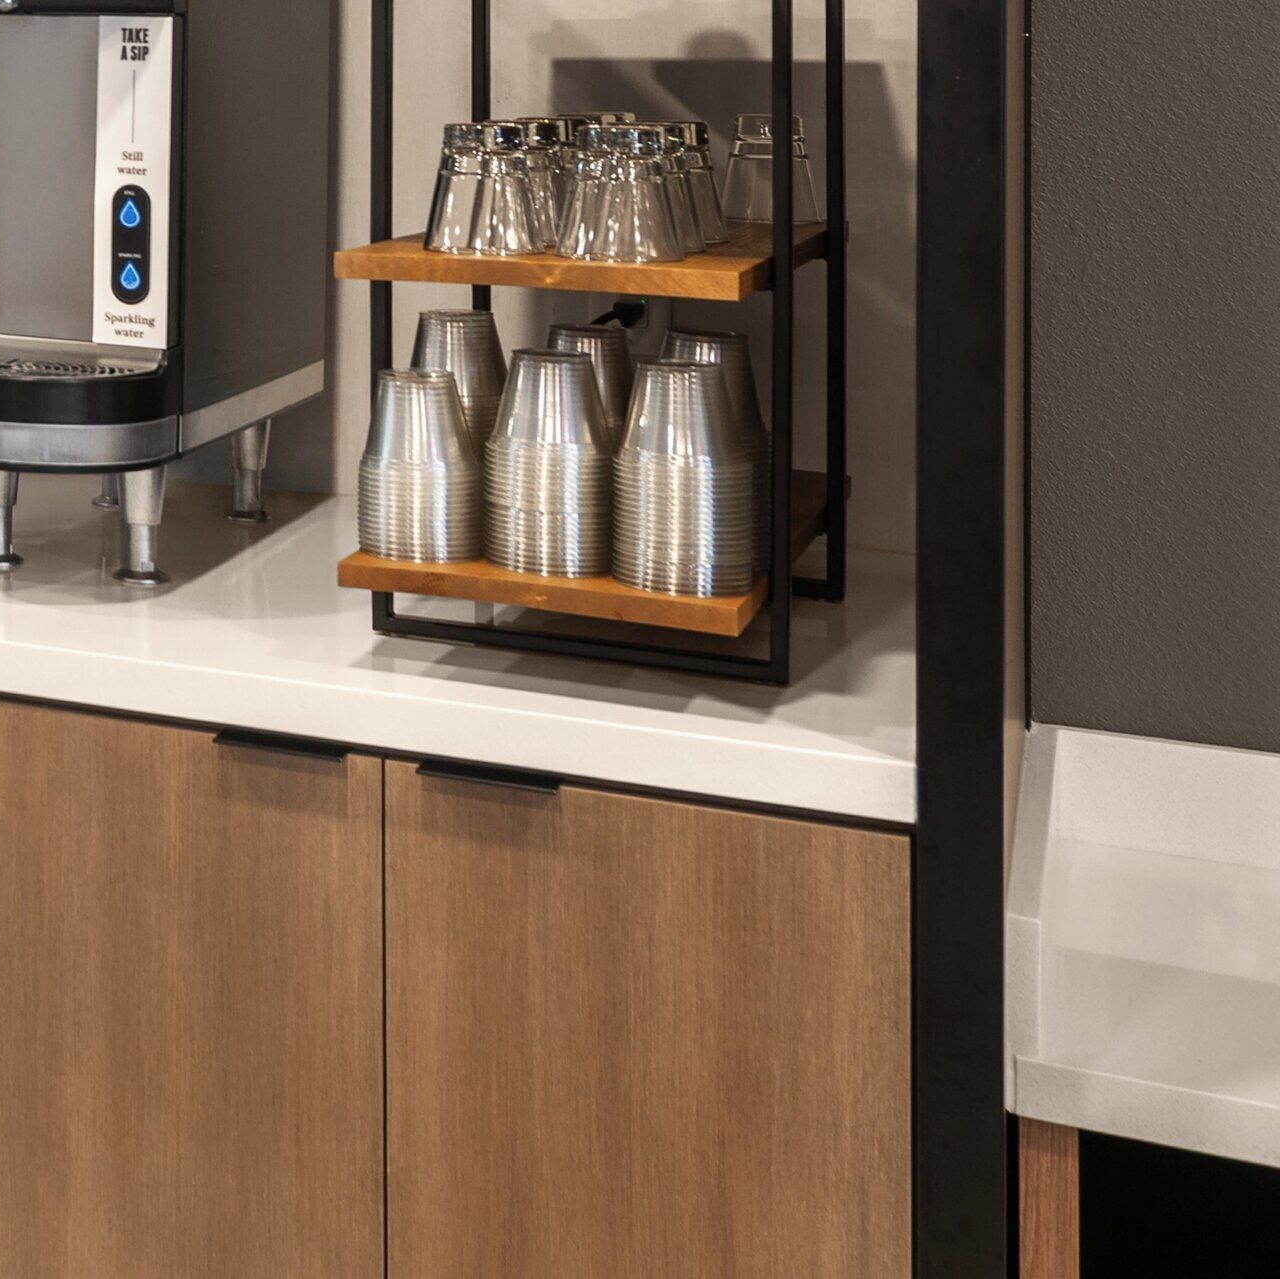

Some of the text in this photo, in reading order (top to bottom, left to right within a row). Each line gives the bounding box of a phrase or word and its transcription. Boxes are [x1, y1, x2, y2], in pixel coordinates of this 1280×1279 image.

[121, 27, 149, 44] TAKE
[120, 45, 149, 61] A SIP
[121, 150, 144, 161] Still
[116, 166, 148, 176] water
[104, 312, 156, 328] Sparkling
[114, 328, 145, 339] water
